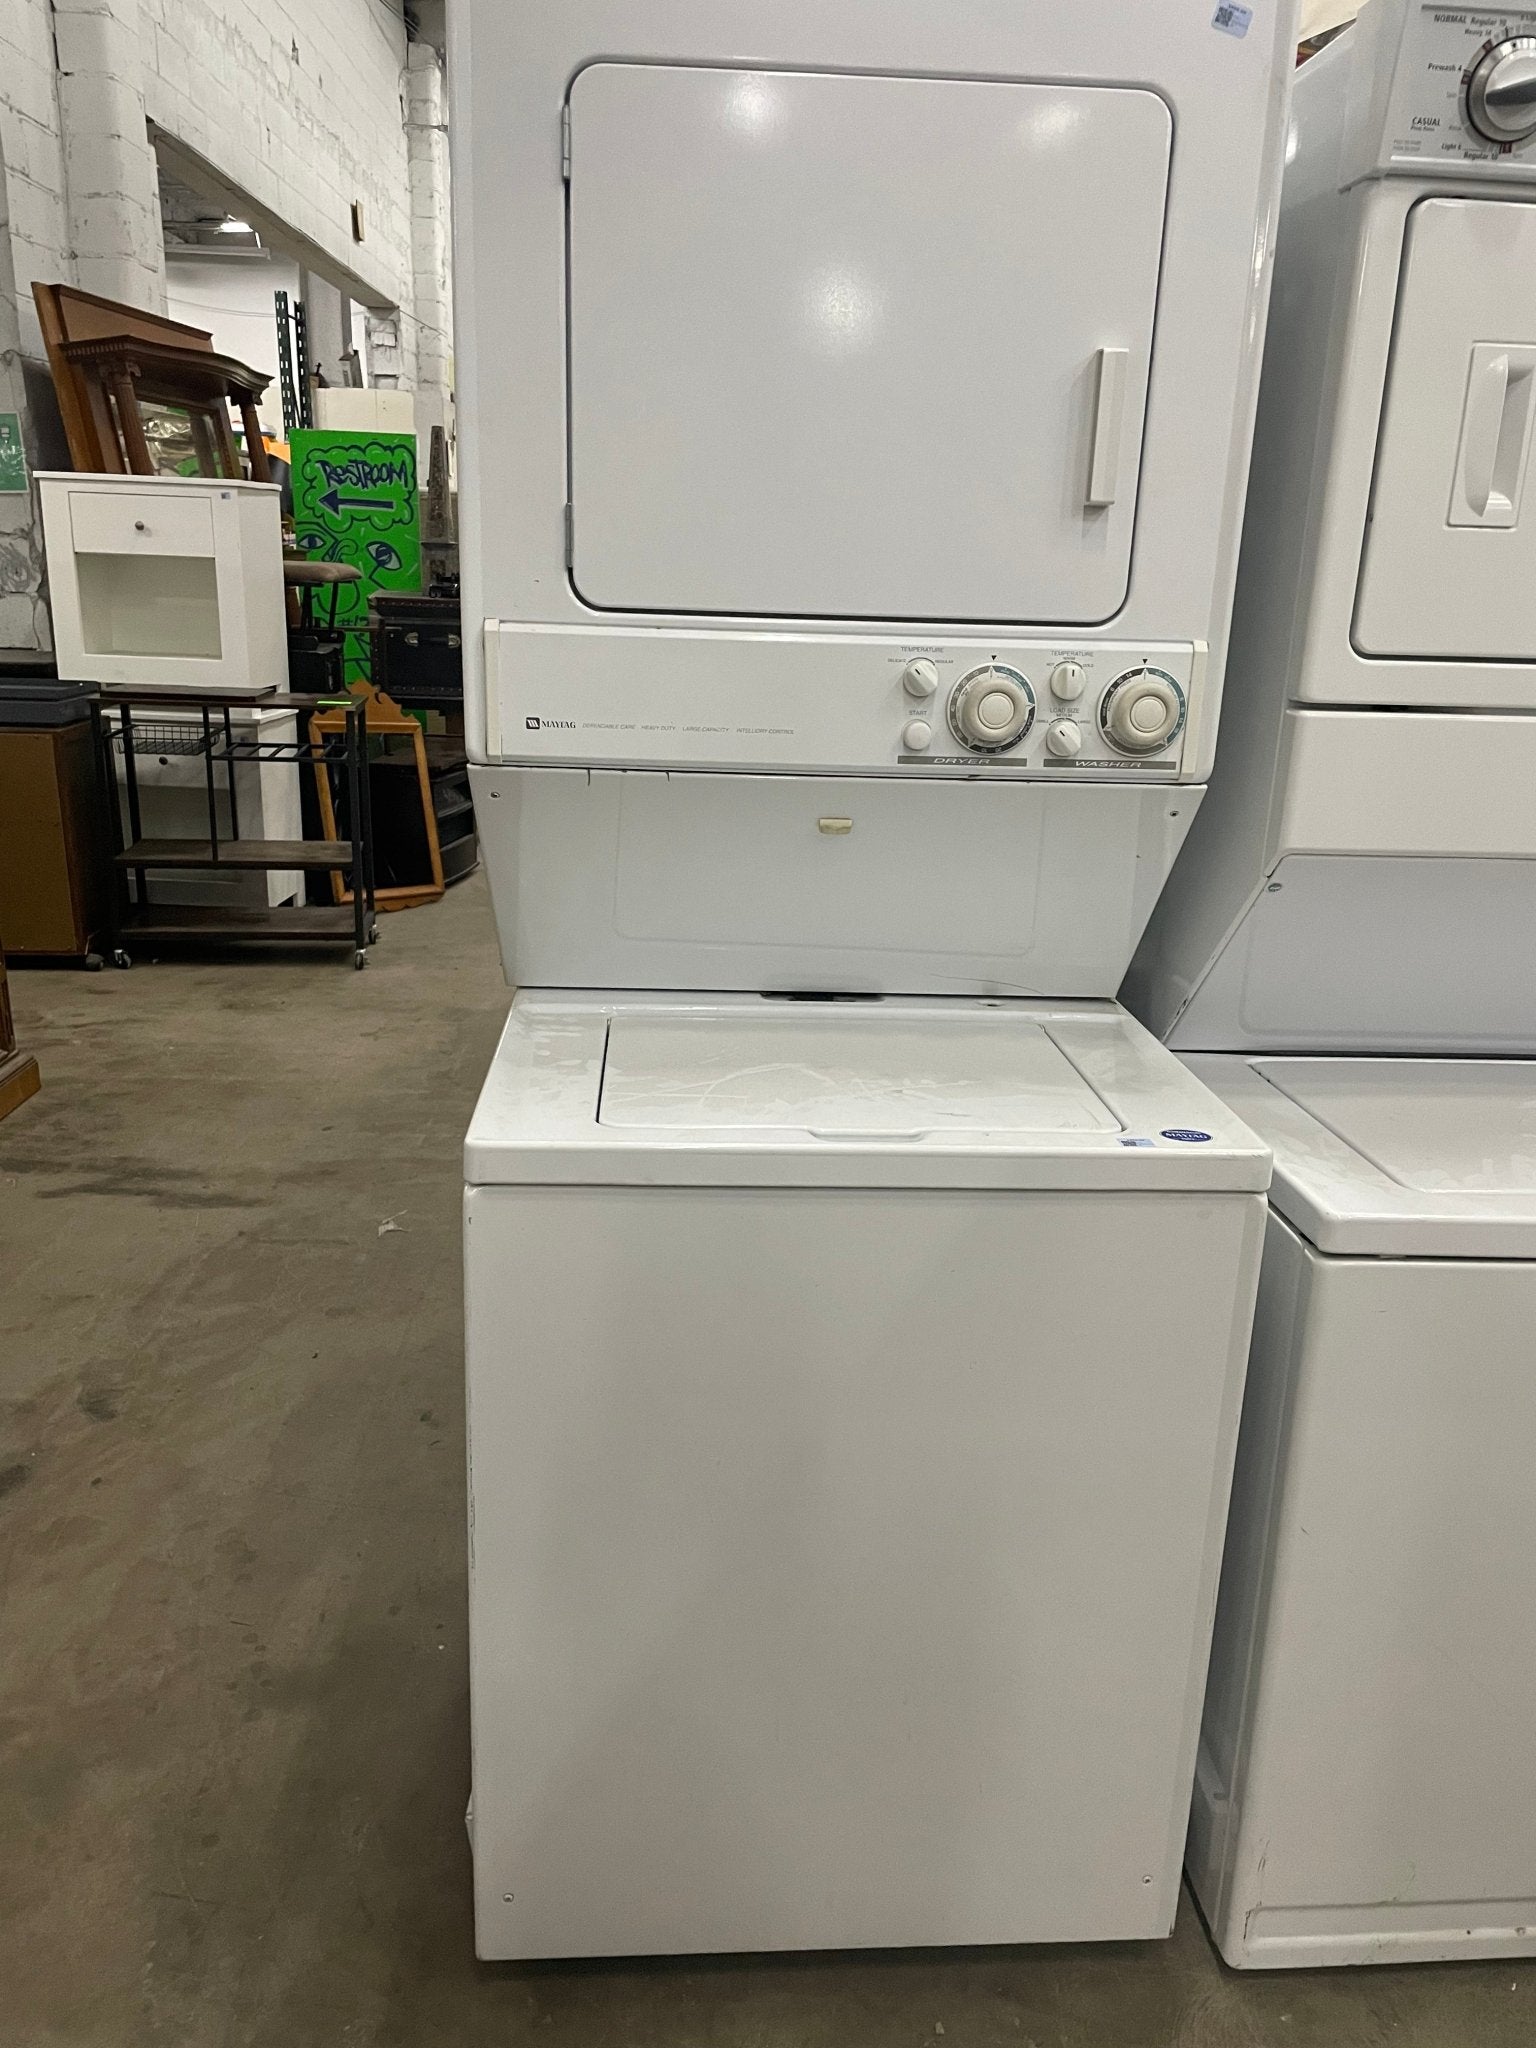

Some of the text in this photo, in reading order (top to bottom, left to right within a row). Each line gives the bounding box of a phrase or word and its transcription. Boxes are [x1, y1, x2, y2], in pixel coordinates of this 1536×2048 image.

[1434, 14, 1467, 24] NORMAL
[1470, 16, 1497, 27] Regular
[1427, 62, 1456, 71] Prewash
[1411, 116, 1441, 126] CASUAL
[1442, 143, 1457, 152] Light
[1463, 151, 1489, 160] Regular
[541, 720, 576, 729] MAYTAG
[933, 757, 990, 765] DRYER
[1075, 760, 1141, 768] WASHER
